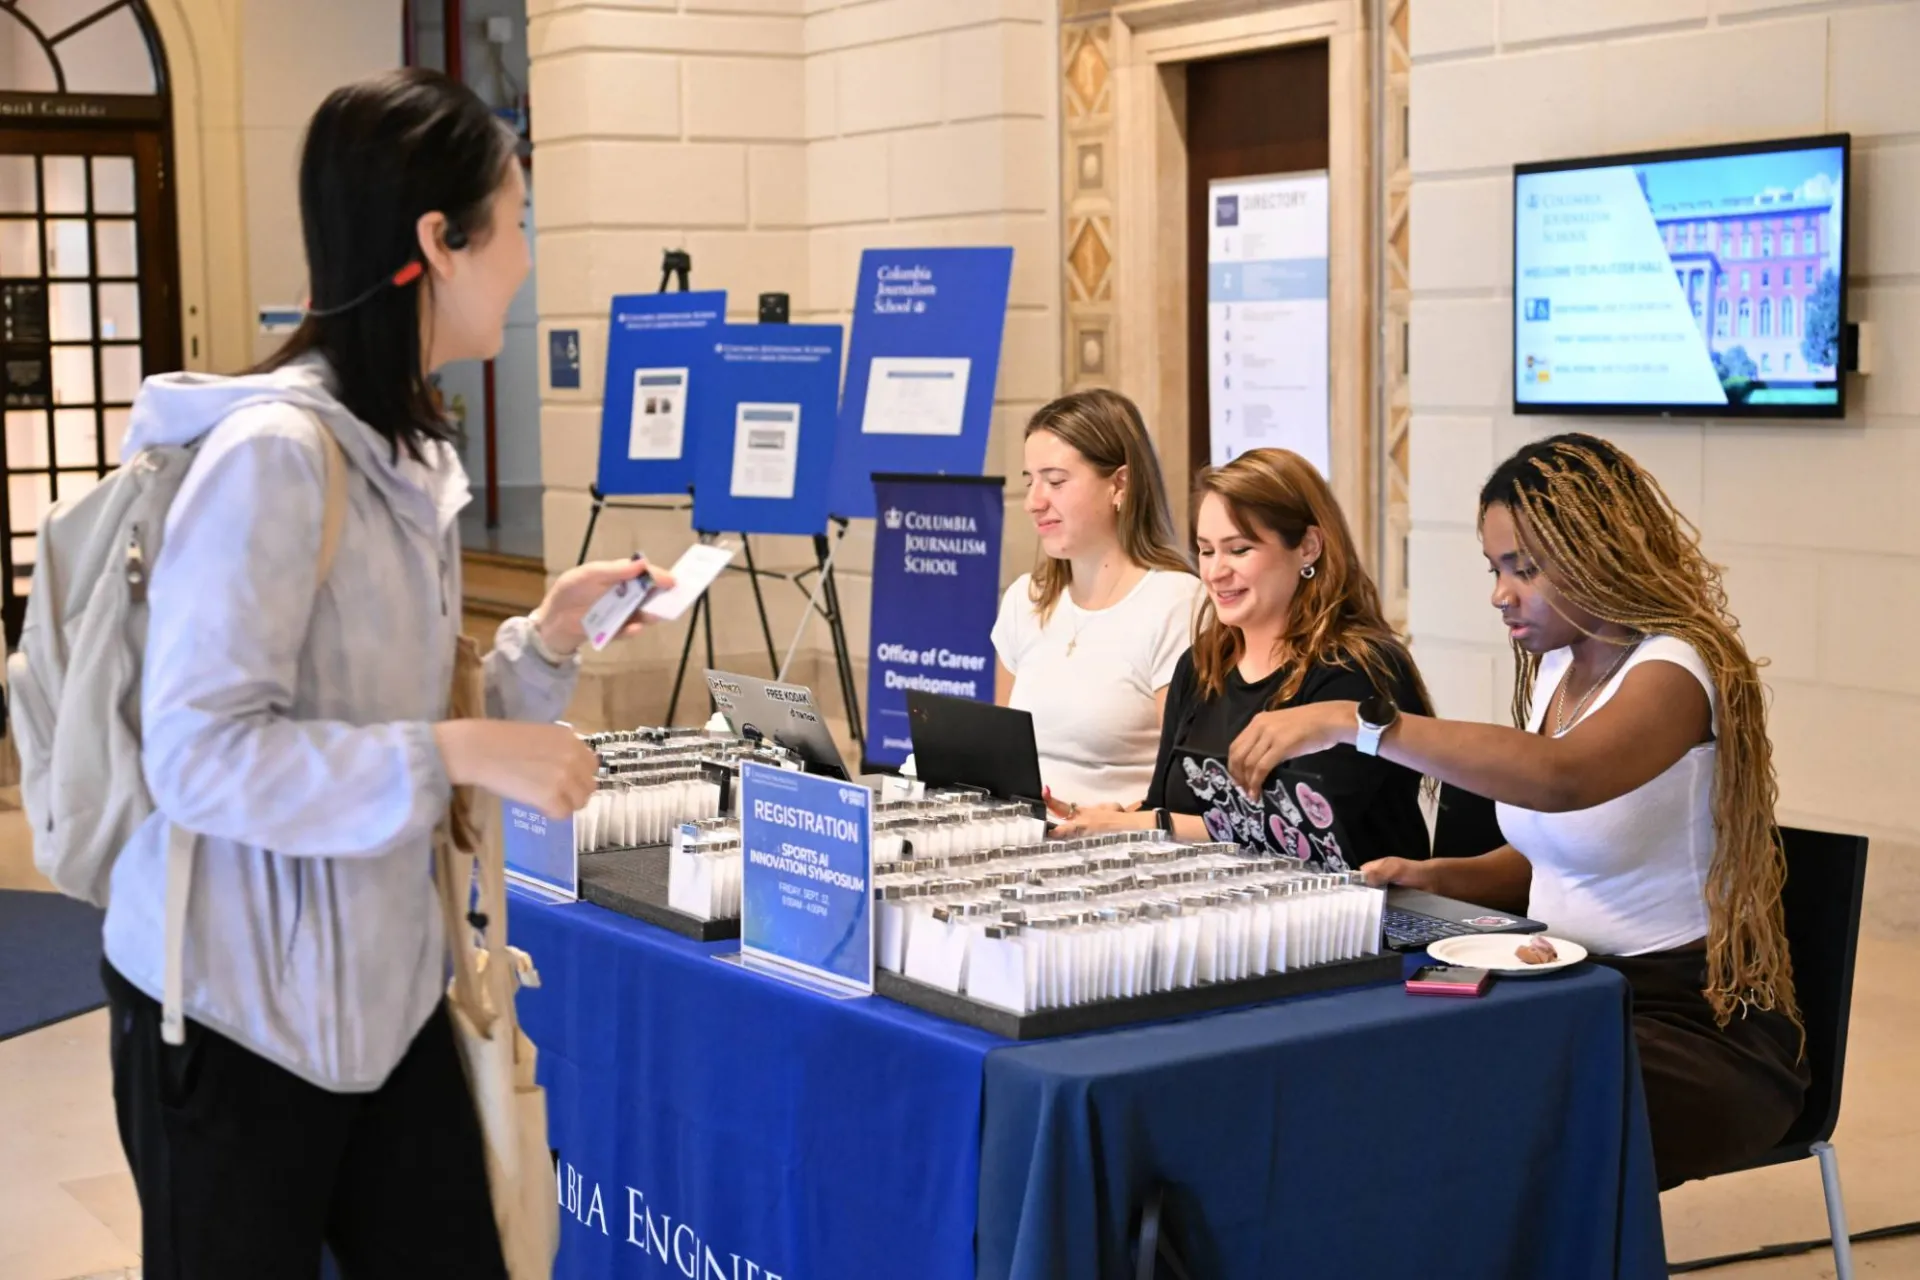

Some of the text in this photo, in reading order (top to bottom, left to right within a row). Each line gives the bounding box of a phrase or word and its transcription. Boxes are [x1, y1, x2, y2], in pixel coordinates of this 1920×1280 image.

[0, 101, 106, 117] ent Center
[1243, 190, 1308, 210] DIRECTORY
[877, 264, 932, 280] Columbia
[875, 280, 937, 299] Journalism
[873, 297, 912, 314] School
[904, 511, 978, 533] COLUMBIA
[904, 532, 987, 555] JOURNALISM
[904, 554, 958, 576] SCHOOL
[877, 643, 986, 671] Office of Career
[884, 670, 976, 697] Development
[766, 688, 809, 704] FREE KODAK
[754, 799, 859, 843] REGISTRATION
[781, 843, 829, 867] SPORTS AI
[750, 849, 864, 892] INNOVATION SYMPOSIUM
[625, 1186, 782, 1280] ENGIN
